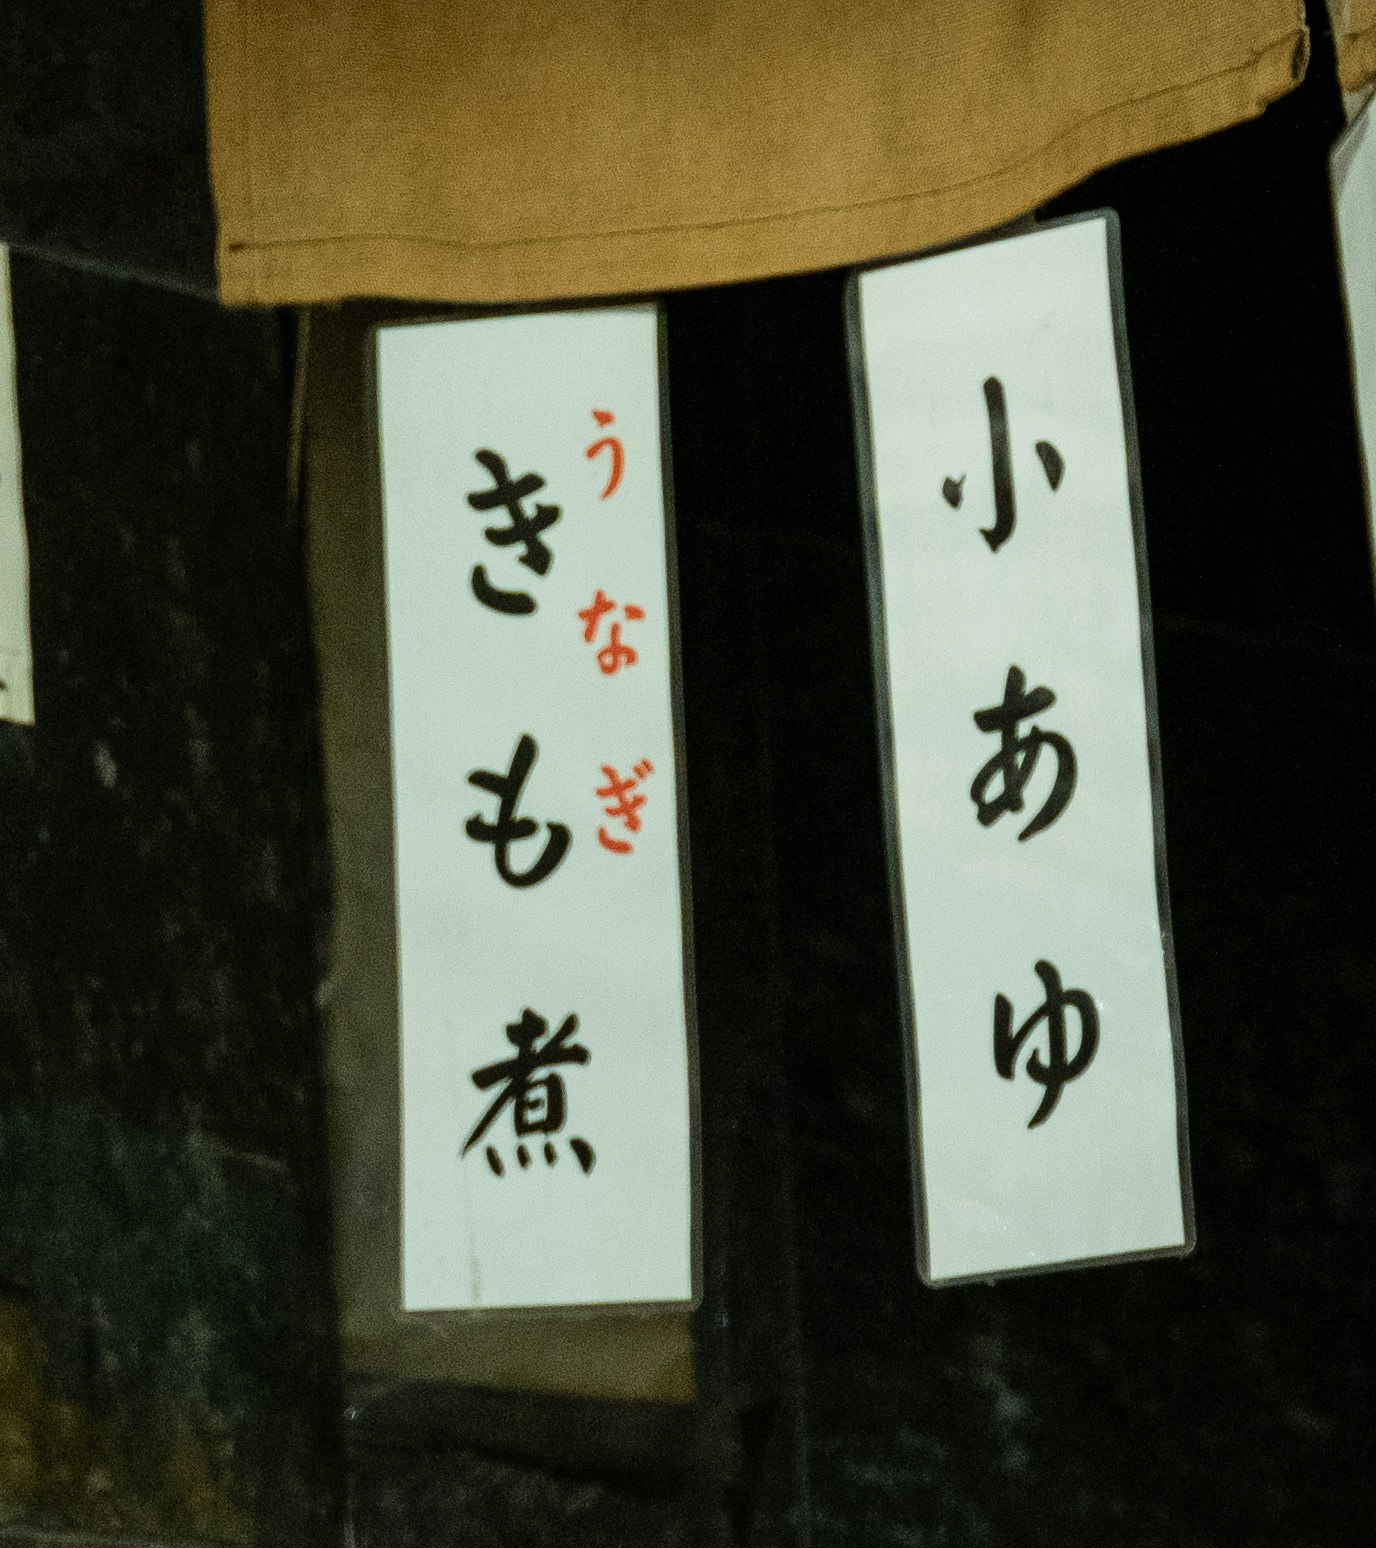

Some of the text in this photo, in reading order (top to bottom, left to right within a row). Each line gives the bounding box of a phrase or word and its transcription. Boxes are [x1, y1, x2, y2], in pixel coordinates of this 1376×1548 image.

[459, 448, 596, 1177] きも煮
[577, 409, 655, 855] うなぎ
[942, 375, 1100, 1129] 小あゆ
